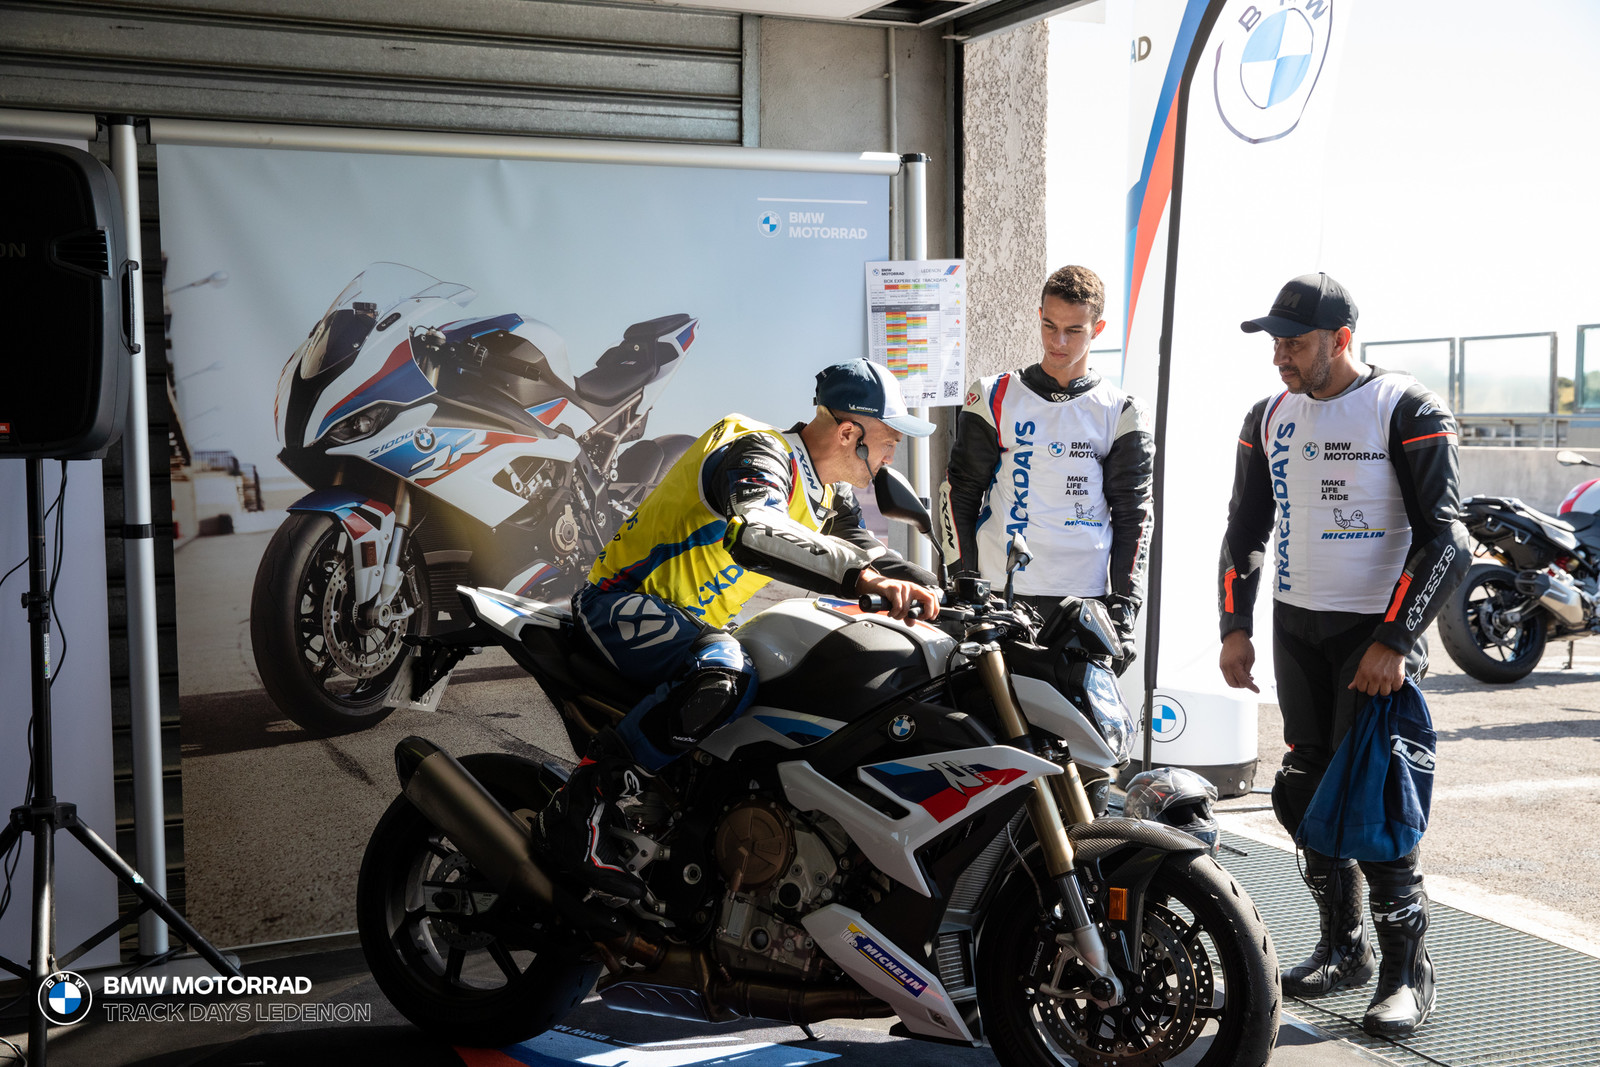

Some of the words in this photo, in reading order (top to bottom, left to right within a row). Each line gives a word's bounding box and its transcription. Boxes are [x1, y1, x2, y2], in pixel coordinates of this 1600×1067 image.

[1238, 0, 1328, 32] BW
[788, 211, 825, 224] BMW
[788, 226, 868, 240] MOTORRAD
[367, 430, 415, 458] S1000
[1324, 442, 1351, 451] BMW
[1068, 450, 1103, 460] MOTO
[1323, 452, 1386, 461] MOTORRAD
[1066, 475, 1089, 483] MAKE
[1321, 479, 1346, 487] MAKE
[1321, 486, 1339, 494] LIFE
[1006, 420, 1036, 573] ACKDAYS
[1320, 493, 1328, 501] A
[1328, 493, 1349, 501] RIDE
[1270, 422, 1296, 593] TRACKDAYS
[1321, 531, 1386, 540] MICHELIN
[1406, 544, 1457, 632] alpinestars
[862, 943, 923, 991] MICHELIN
